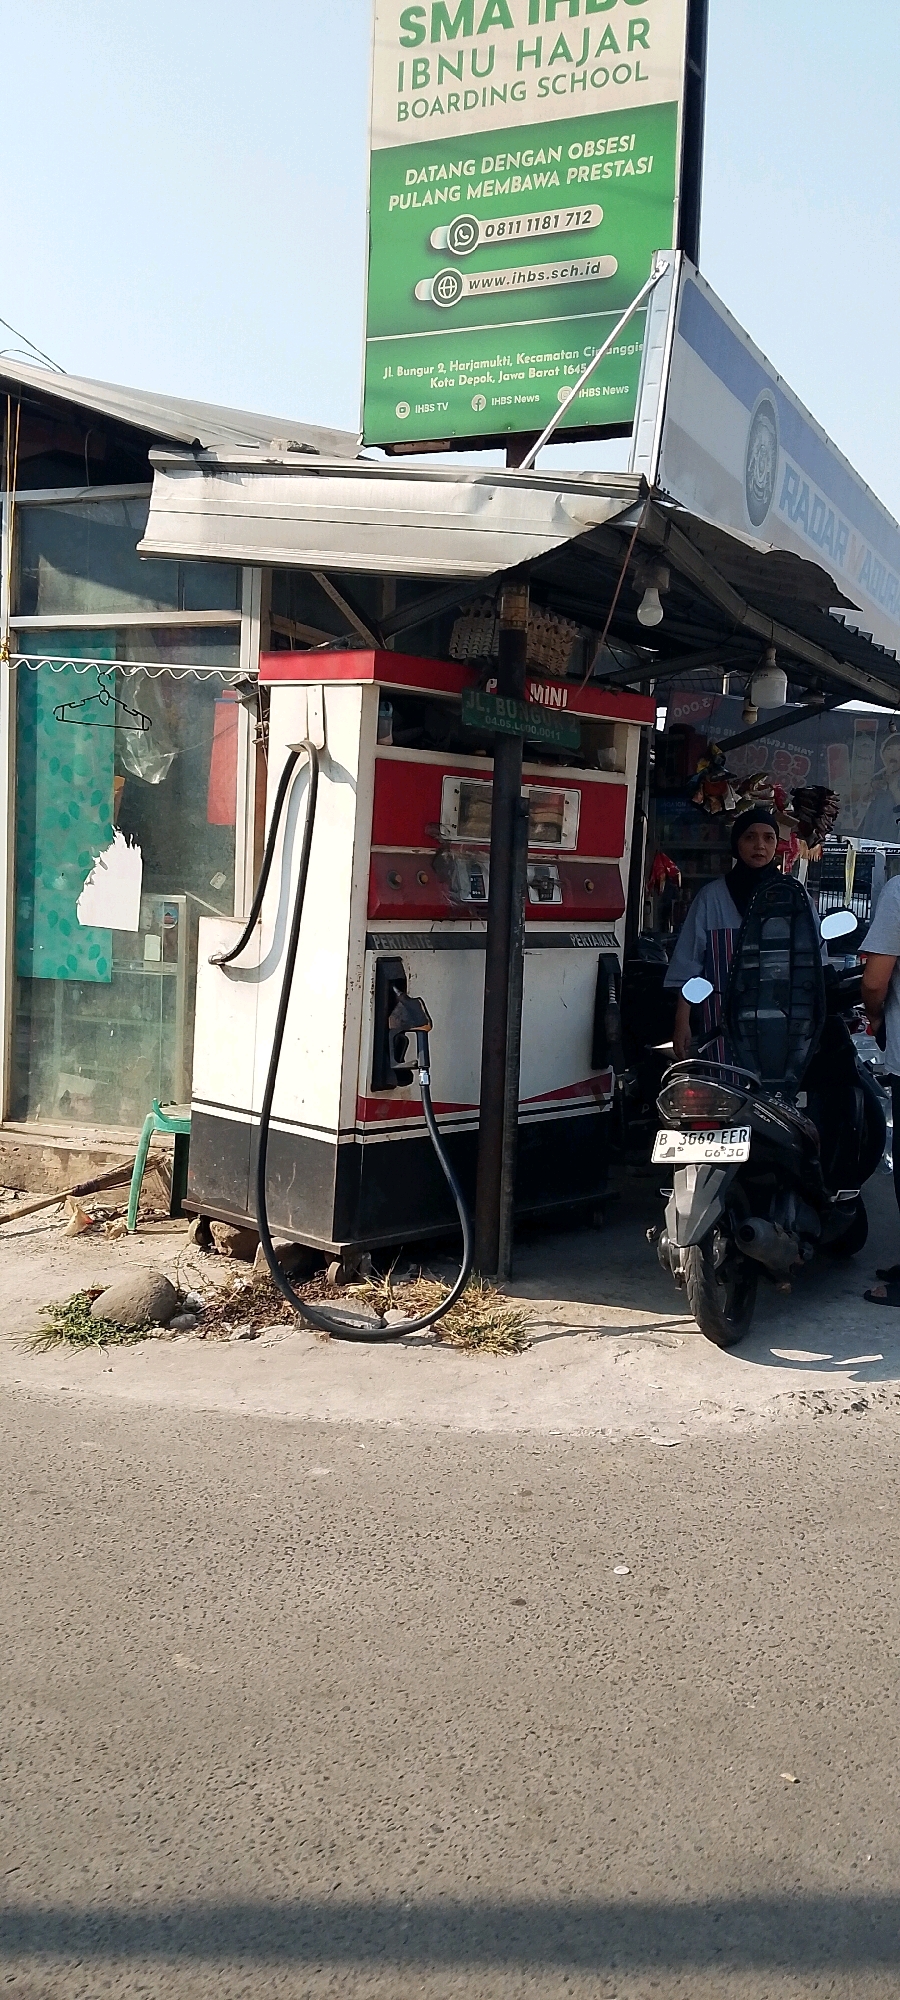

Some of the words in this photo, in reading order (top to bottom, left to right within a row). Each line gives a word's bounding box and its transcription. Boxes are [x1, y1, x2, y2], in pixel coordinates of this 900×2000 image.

[399, 0, 514, 47] SMA
[398, 45, 495, 92] IBNU
[516, 17, 651, 72] HAJAR
[397, 81, 527, 122] BOARDING
[537, 60, 649, 98] SCHOOL
[405, 160, 476, 186] DATANG
[480, 145, 563, 179] DENGAN
[568, 134, 636, 160] OBSESI
[388, 185, 462, 212] PULANG
[466, 170, 560, 201] MEMBAWA
[566, 156, 654, 185] PRESTASI
[485, 220, 522, 237] 0811
[526, 215, 560, 233] 1181
[564, 210, 592, 227] 712
[468, 262, 601, 291] www.ihbs.sch.id
[397, 366, 434, 377] Bungur
[449, 354, 513, 372] Harjamukti,
[516, 349, 579, 365] Kecamatan
[583, 342, 644, 357] Cianggis
[430, 377, 455, 389] Kota
[458, 372, 495, 387] Depok,
[498, 371, 525, 383] Jawa
[528, 366, 560, 378] Barat
[563, 363, 588, 375] 1645
[491, 396, 513, 406] IHBS
[514, 394, 540, 404] News
[579, 387, 601, 398] IHBS
[602, 385, 630, 396] News
[415, 403, 435, 414] IHBS
[437, 402, 449, 411] TV
[779, 463, 849, 567] RADAR
[466, 690, 489, 713] JL.
[529, 682, 568, 707] MINI
[372, 934, 433, 950] PERTALITE
[570, 933, 620, 947] PERTAMAX
[659, 1133, 668, 1145] B
[721, 1129, 748, 1144] EER
